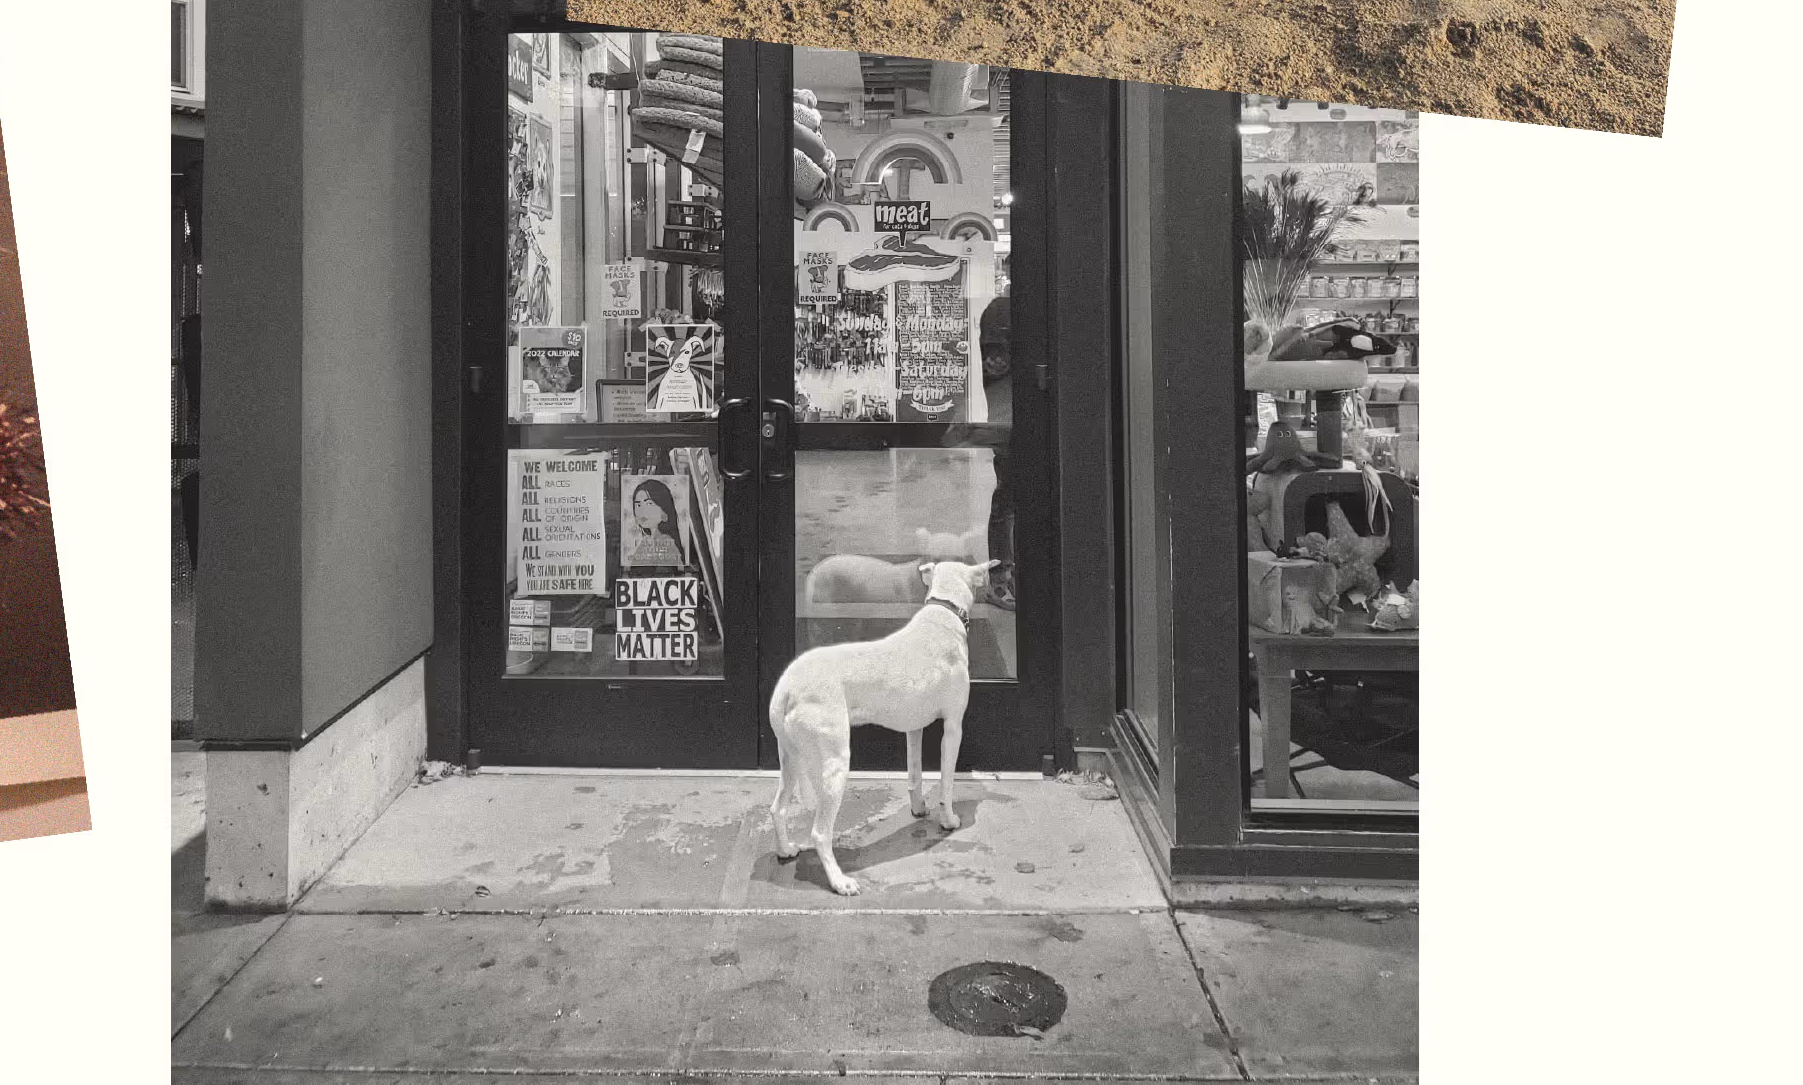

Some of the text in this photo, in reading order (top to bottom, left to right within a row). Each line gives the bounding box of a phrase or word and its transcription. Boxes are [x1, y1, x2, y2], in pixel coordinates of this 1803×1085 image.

[876, 202, 929, 226] meat
[803, 257, 833, 265] MASKS
[608, 265, 631, 273] FACE
[800, 295, 837, 304] REQUIRED
[602, 309, 640, 318] REQUIRED
[547, 349, 581, 357] CALENDAR
[524, 460, 598, 474] WE WELCOME
[522, 475, 571, 490] ALL RACES
[522, 491, 539, 505] ALL
[522, 508, 542, 523] ALL
[522, 527, 542, 542] ALL
[544, 525, 576, 533] SEXUAL
[522, 545, 582, 561] ALL GENDERS
[574, 564, 595, 577] YOU
[551, 578, 577, 591] SAFE
[616, 579, 697, 607] BLACK
[616, 609, 697, 632] LIVES
[616, 633, 697, 659] MATTER
